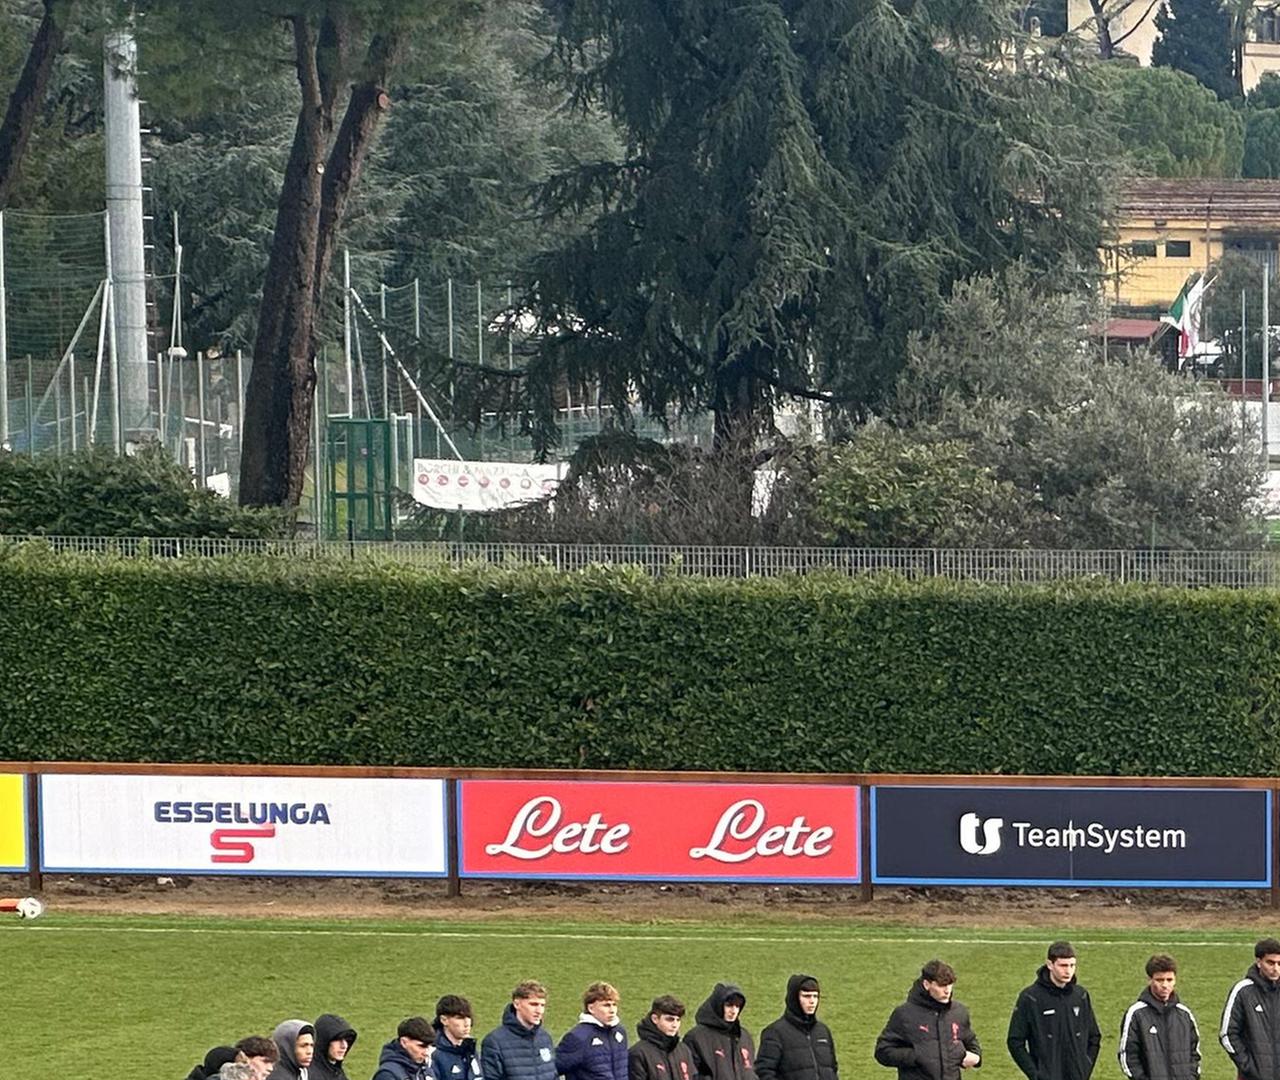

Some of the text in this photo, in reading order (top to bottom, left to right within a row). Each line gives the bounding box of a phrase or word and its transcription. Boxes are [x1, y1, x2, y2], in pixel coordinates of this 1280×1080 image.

[153, 801, 331, 825] ESSELUNGA
[485, 795, 836, 864] Lete Lete
[1012, 822, 1186, 854] TeamSystem
